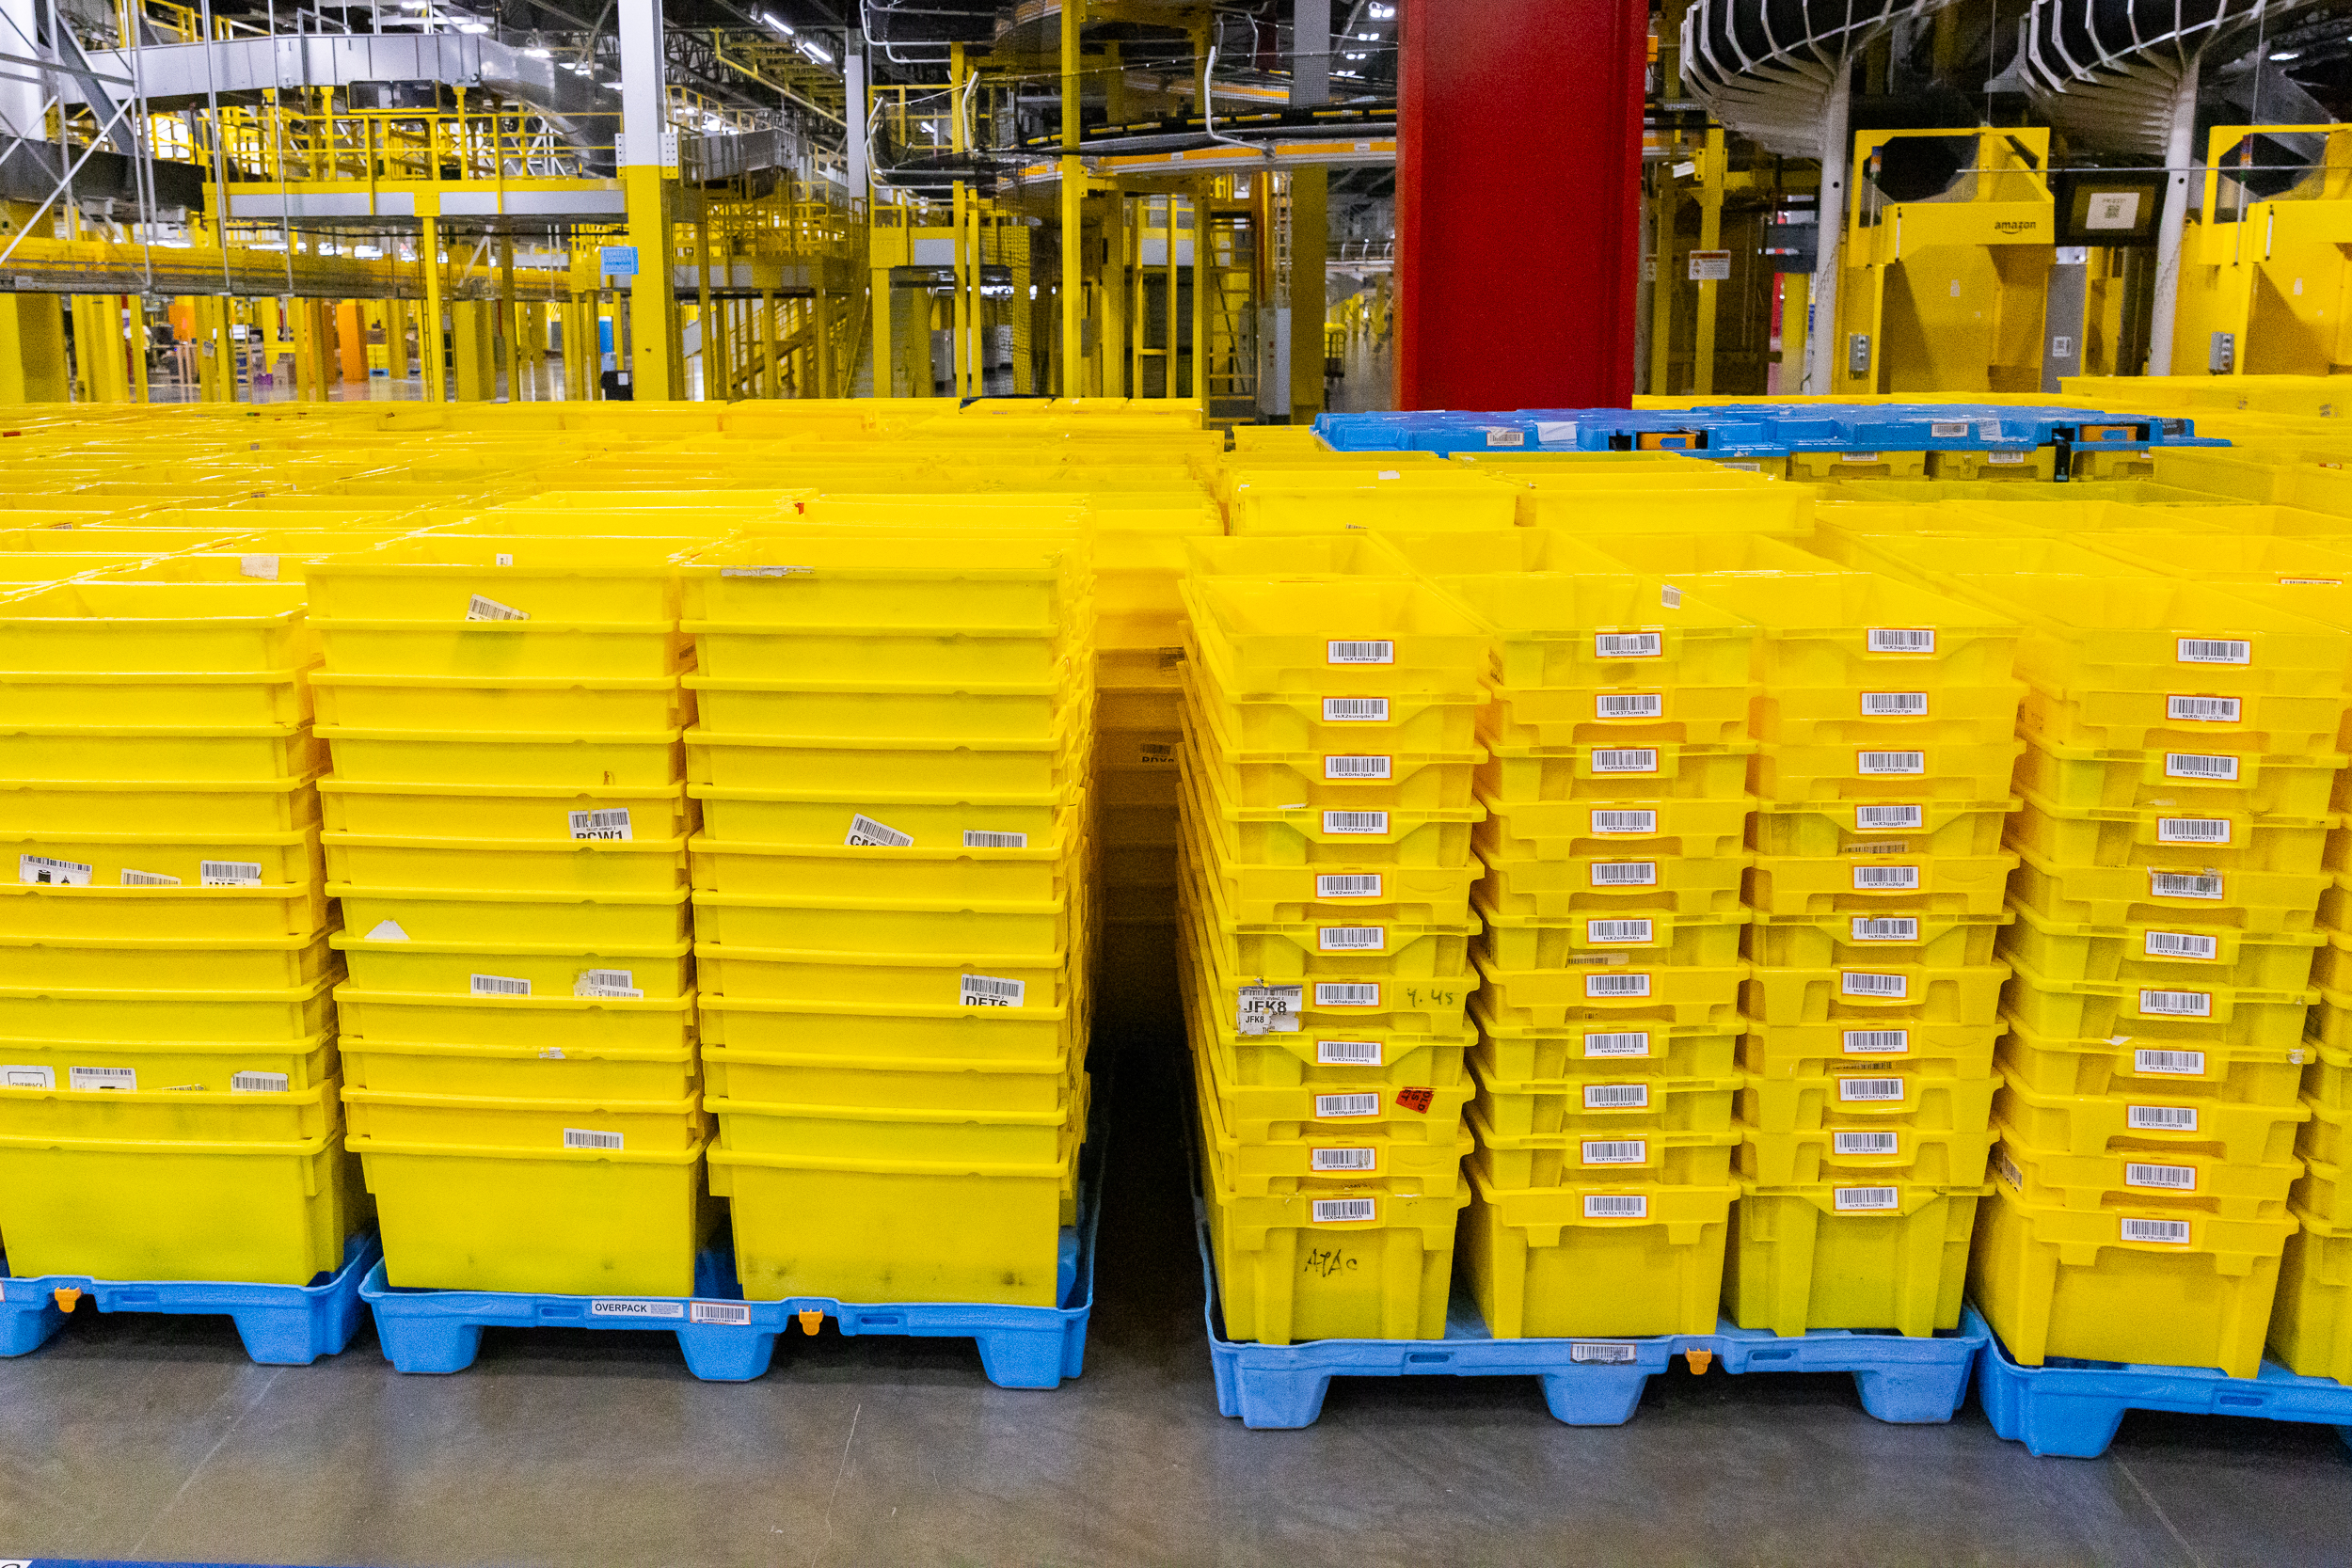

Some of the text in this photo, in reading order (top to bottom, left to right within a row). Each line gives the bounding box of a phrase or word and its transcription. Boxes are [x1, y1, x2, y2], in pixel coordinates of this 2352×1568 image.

[1994, 220, 2036, 230] amazon
[1244, 1001, 1287, 1013] JFK8
[595, 1303, 647, 1312] OVERPACK
